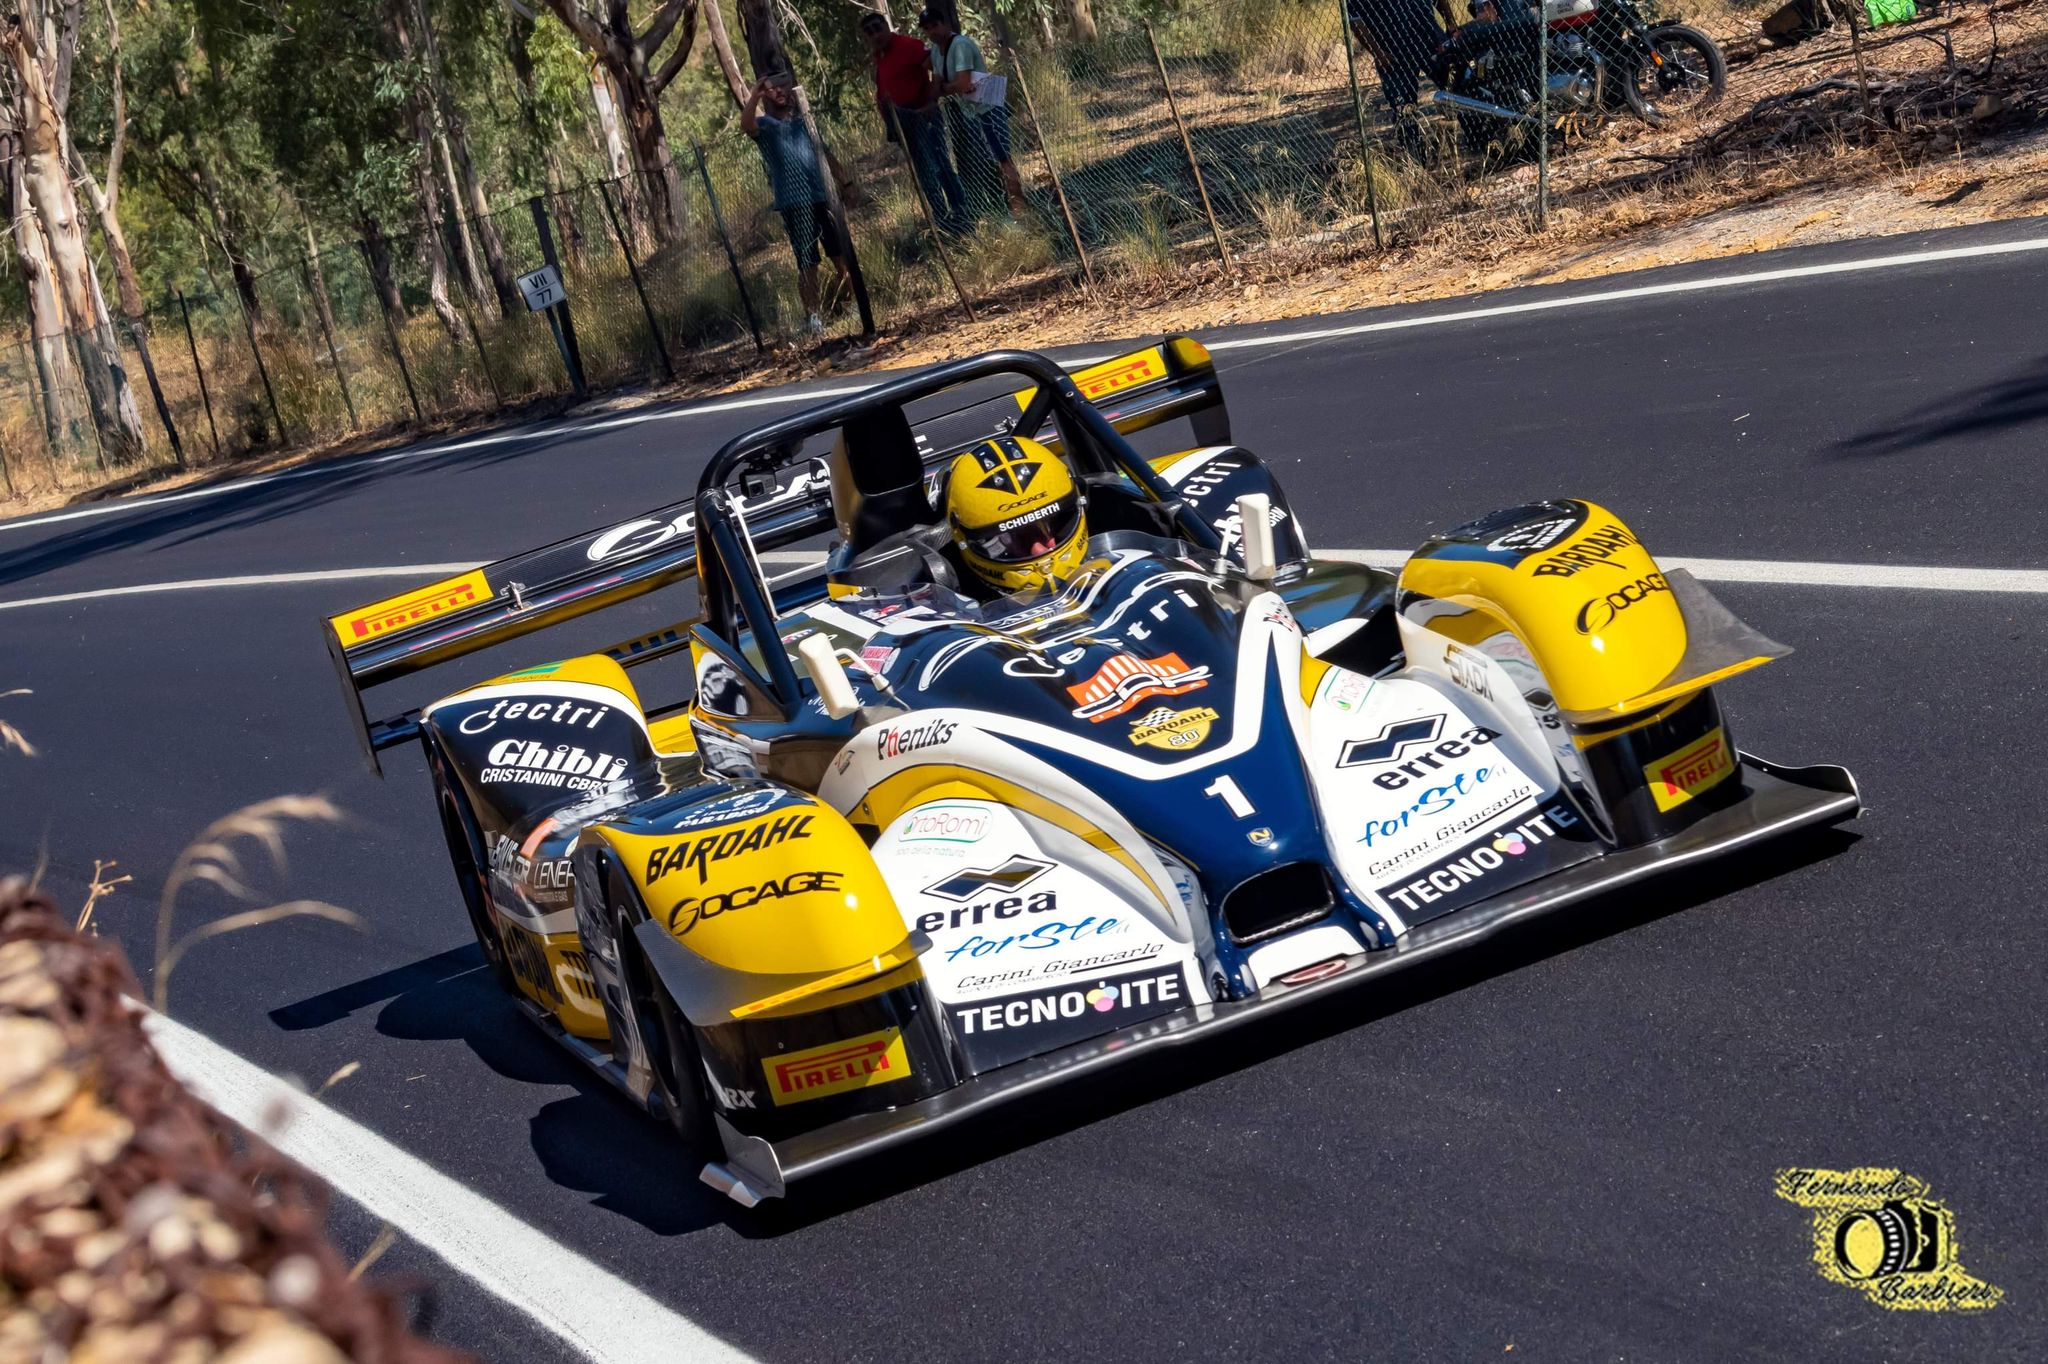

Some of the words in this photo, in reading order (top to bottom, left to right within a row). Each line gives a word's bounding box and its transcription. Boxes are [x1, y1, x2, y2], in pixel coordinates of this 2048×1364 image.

[998, 503, 1061, 532] SCHUBERTH
[350, 583, 476, 638] PIRELLI
[877, 718, 960, 761] Pheniks
[1134, 711, 1213, 740] BARDAHL
[1167, 728, 1200, 748] 80
[480, 768, 565, 788] CRISTANINI
[487, 739, 629, 782] Ghibli
[1660, 738, 1728, 797] PIRELLI
[1203, 774, 1258, 819] 1
[646, 814, 816, 887] BARDAHL
[1368, 838, 1428, 877] Carini
[1435, 783, 1531, 842] Giancarlo
[668, 871, 844, 937] GOCAGE
[956, 965, 1034, 989] Carini
[1043, 942, 1164, 974] Giancarlo
[774, 1040, 891, 1094] PIRELLI
